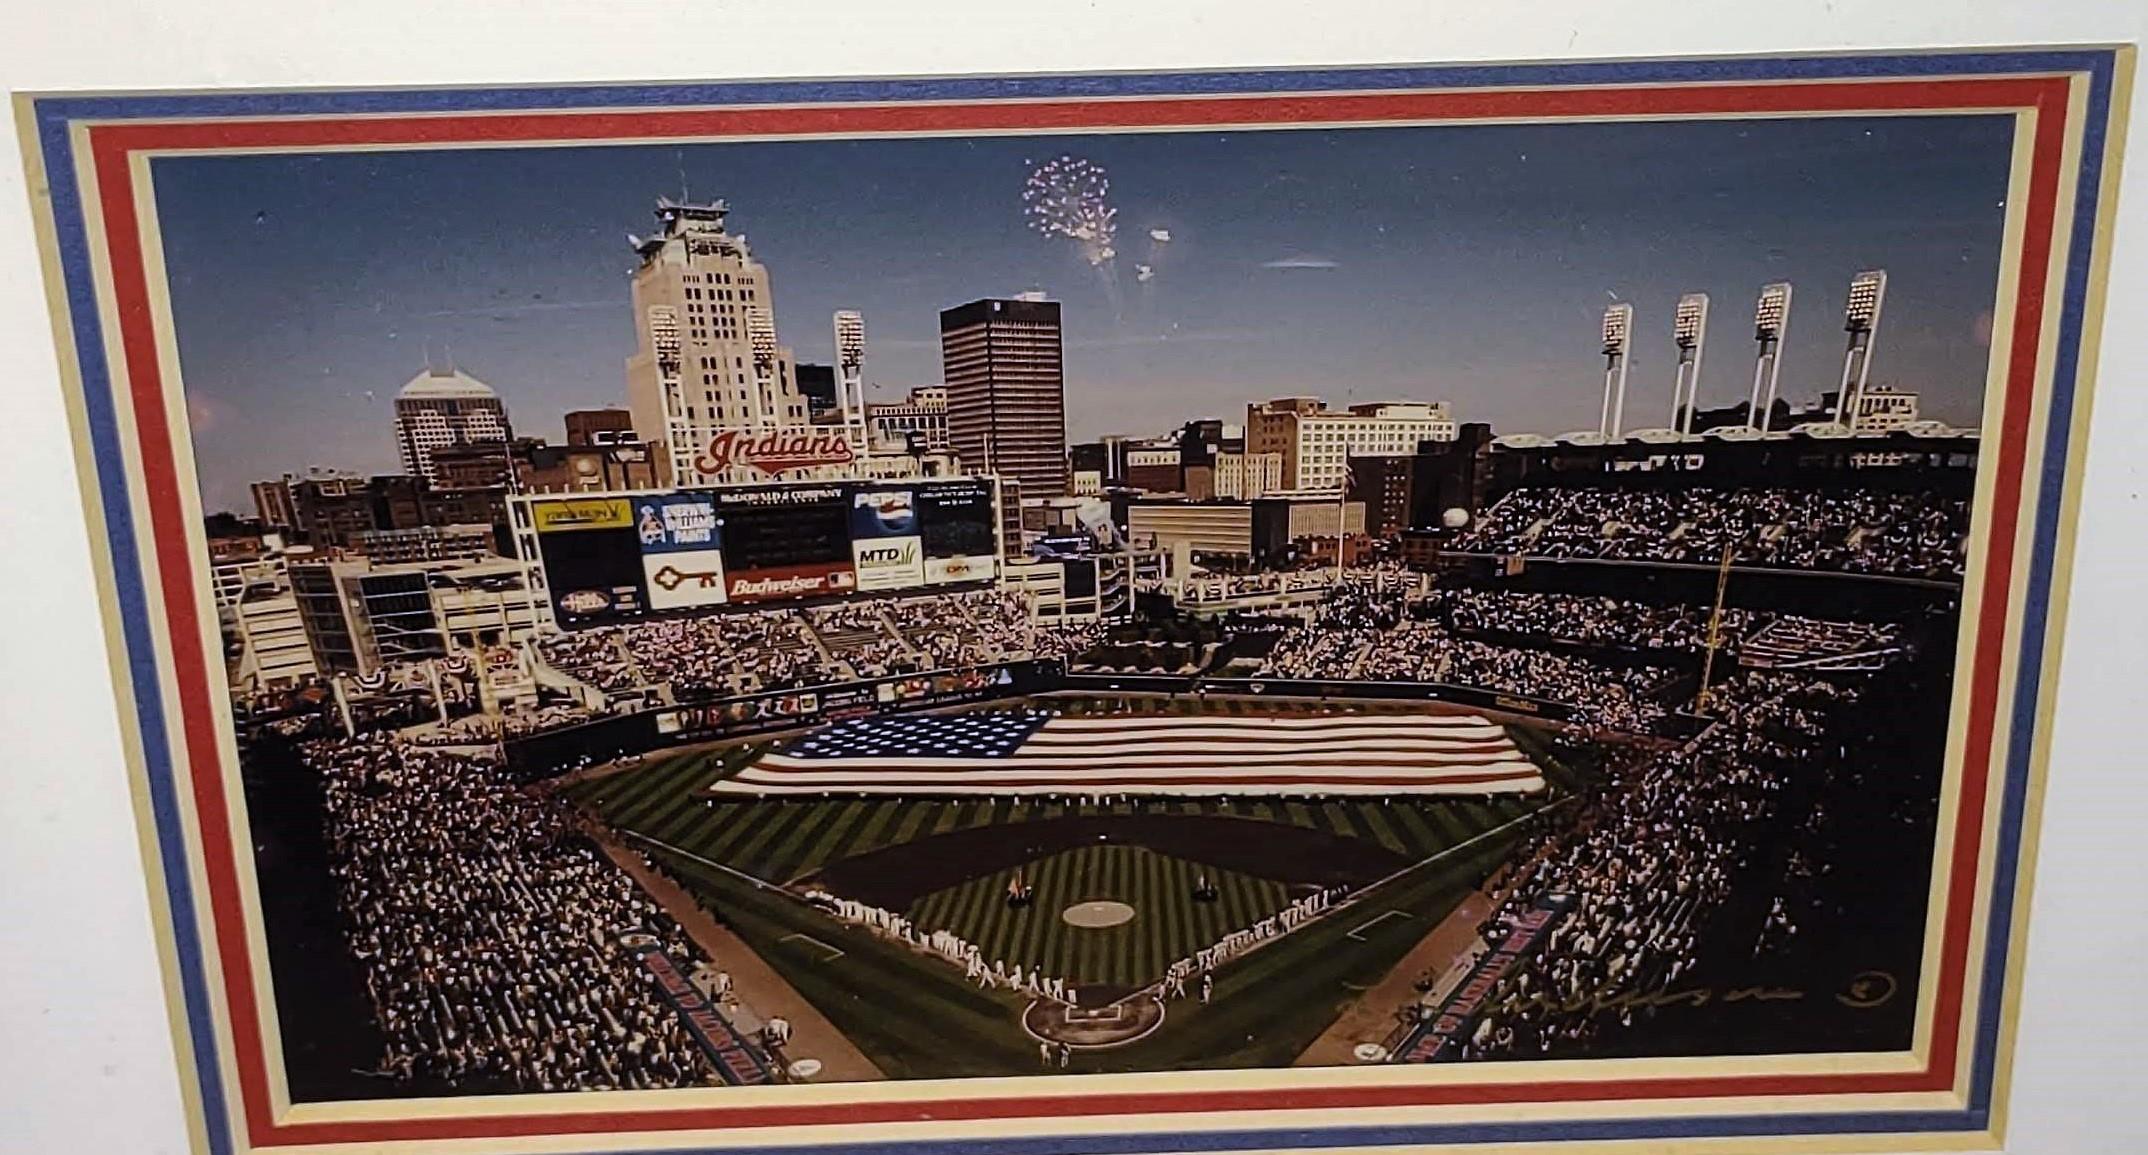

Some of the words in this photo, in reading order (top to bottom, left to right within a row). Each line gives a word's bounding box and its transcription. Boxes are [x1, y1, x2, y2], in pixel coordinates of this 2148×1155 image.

[695, 431, 853, 474] Indians
[860, 548, 899, 562] MTD
[730, 575, 826, 596] Budweiser
